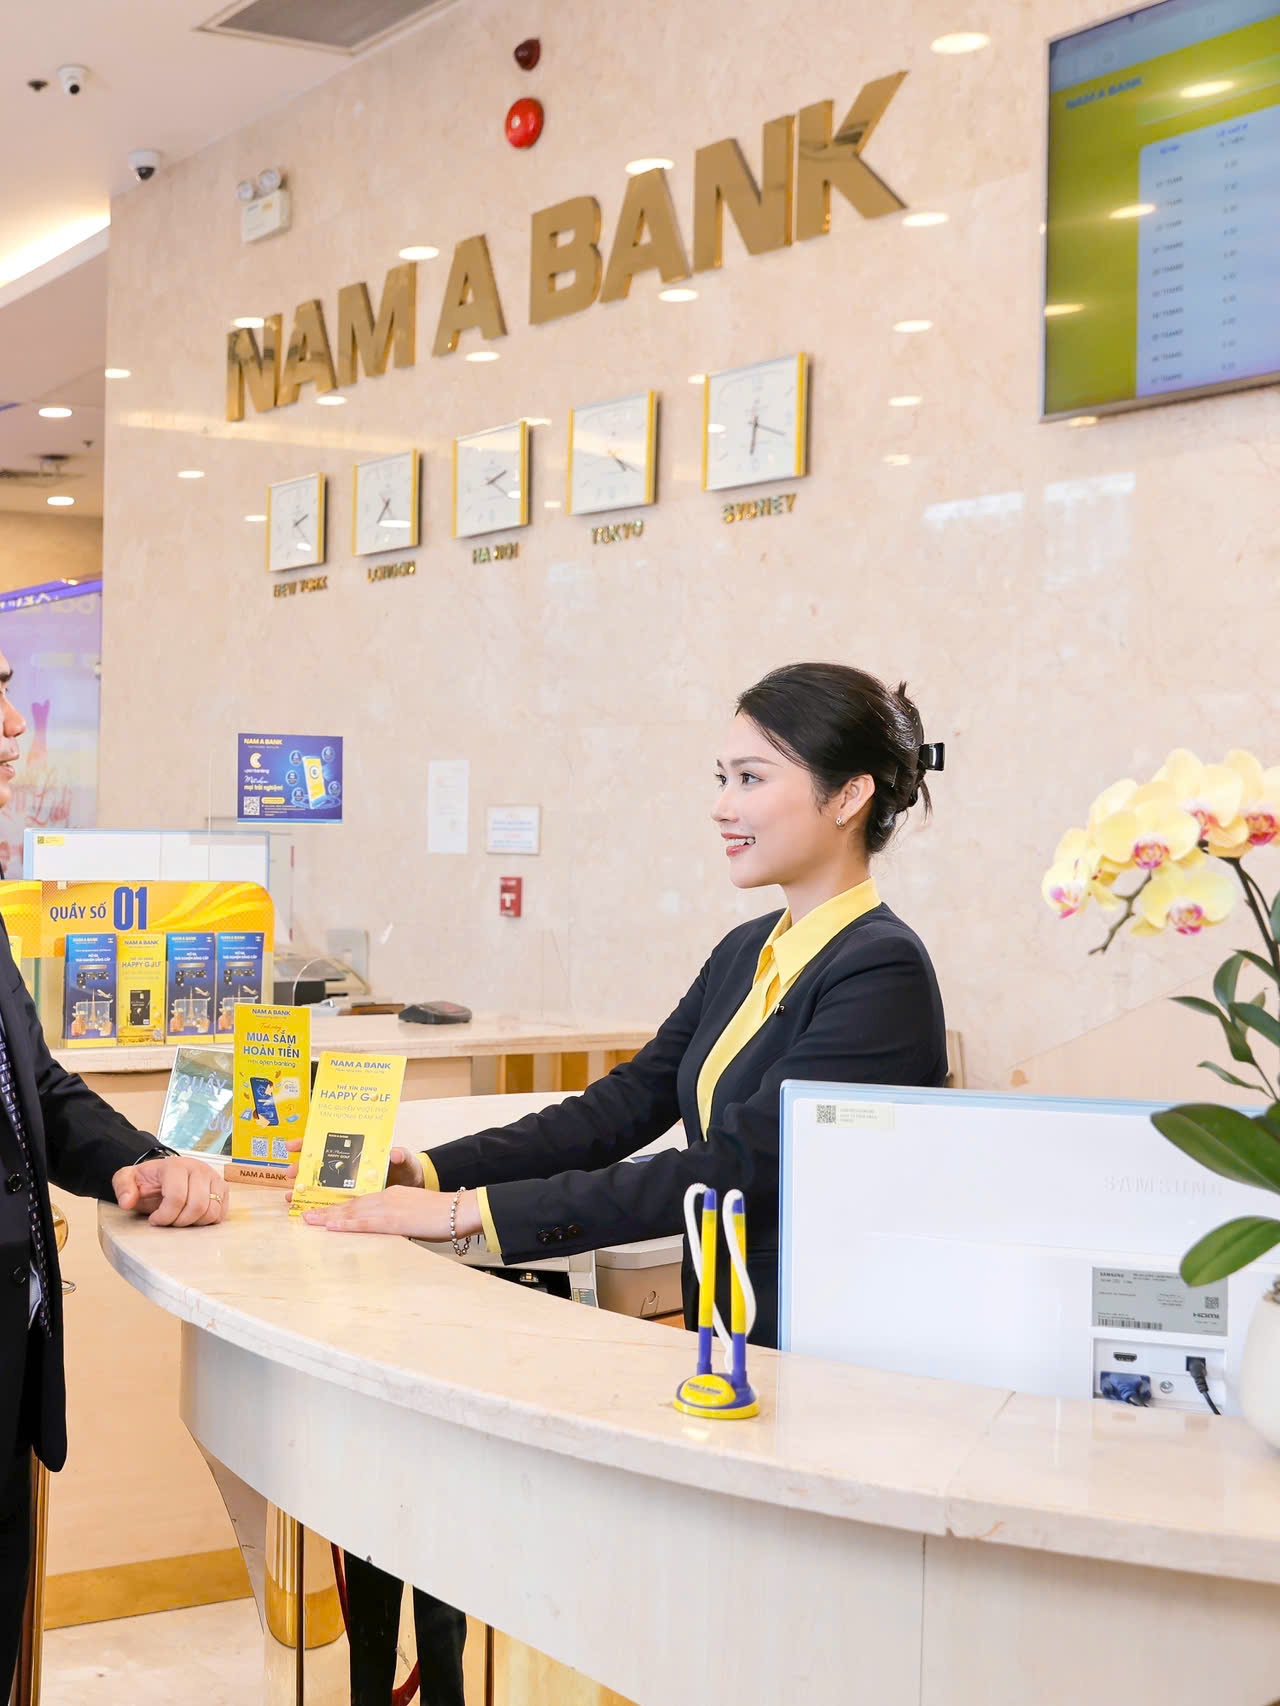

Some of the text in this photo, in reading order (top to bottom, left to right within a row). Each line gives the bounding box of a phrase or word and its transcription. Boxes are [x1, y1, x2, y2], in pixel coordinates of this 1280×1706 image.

[225, 71, 908, 422] NAM A BANK
[720, 493, 797, 525] SYDNEY
[590, 519, 645, 545] TOKYO
[471, 546, 491, 565] HA
[366, 560, 417, 583] LONDON
[273, 575, 328, 598] NEW YORK
[244, 737, 259, 745] NAM
[265, 738, 283, 746] BANK
[49, 886, 148, 931] QUẦY SỐ 01
[247, 1029, 296, 1044] MUA SẮM
[243, 1043, 300, 1058] HOÀN TIỀN
[274, 1060, 296, 1069] banking
[330, 1059, 354, 1068] NAM
[364, 1061, 392, 1070] BANK
[320, 1089, 358, 1101] HAPPY
[239, 1170, 258, 1178] NAM
[265, 1172, 287, 1181] BANK
